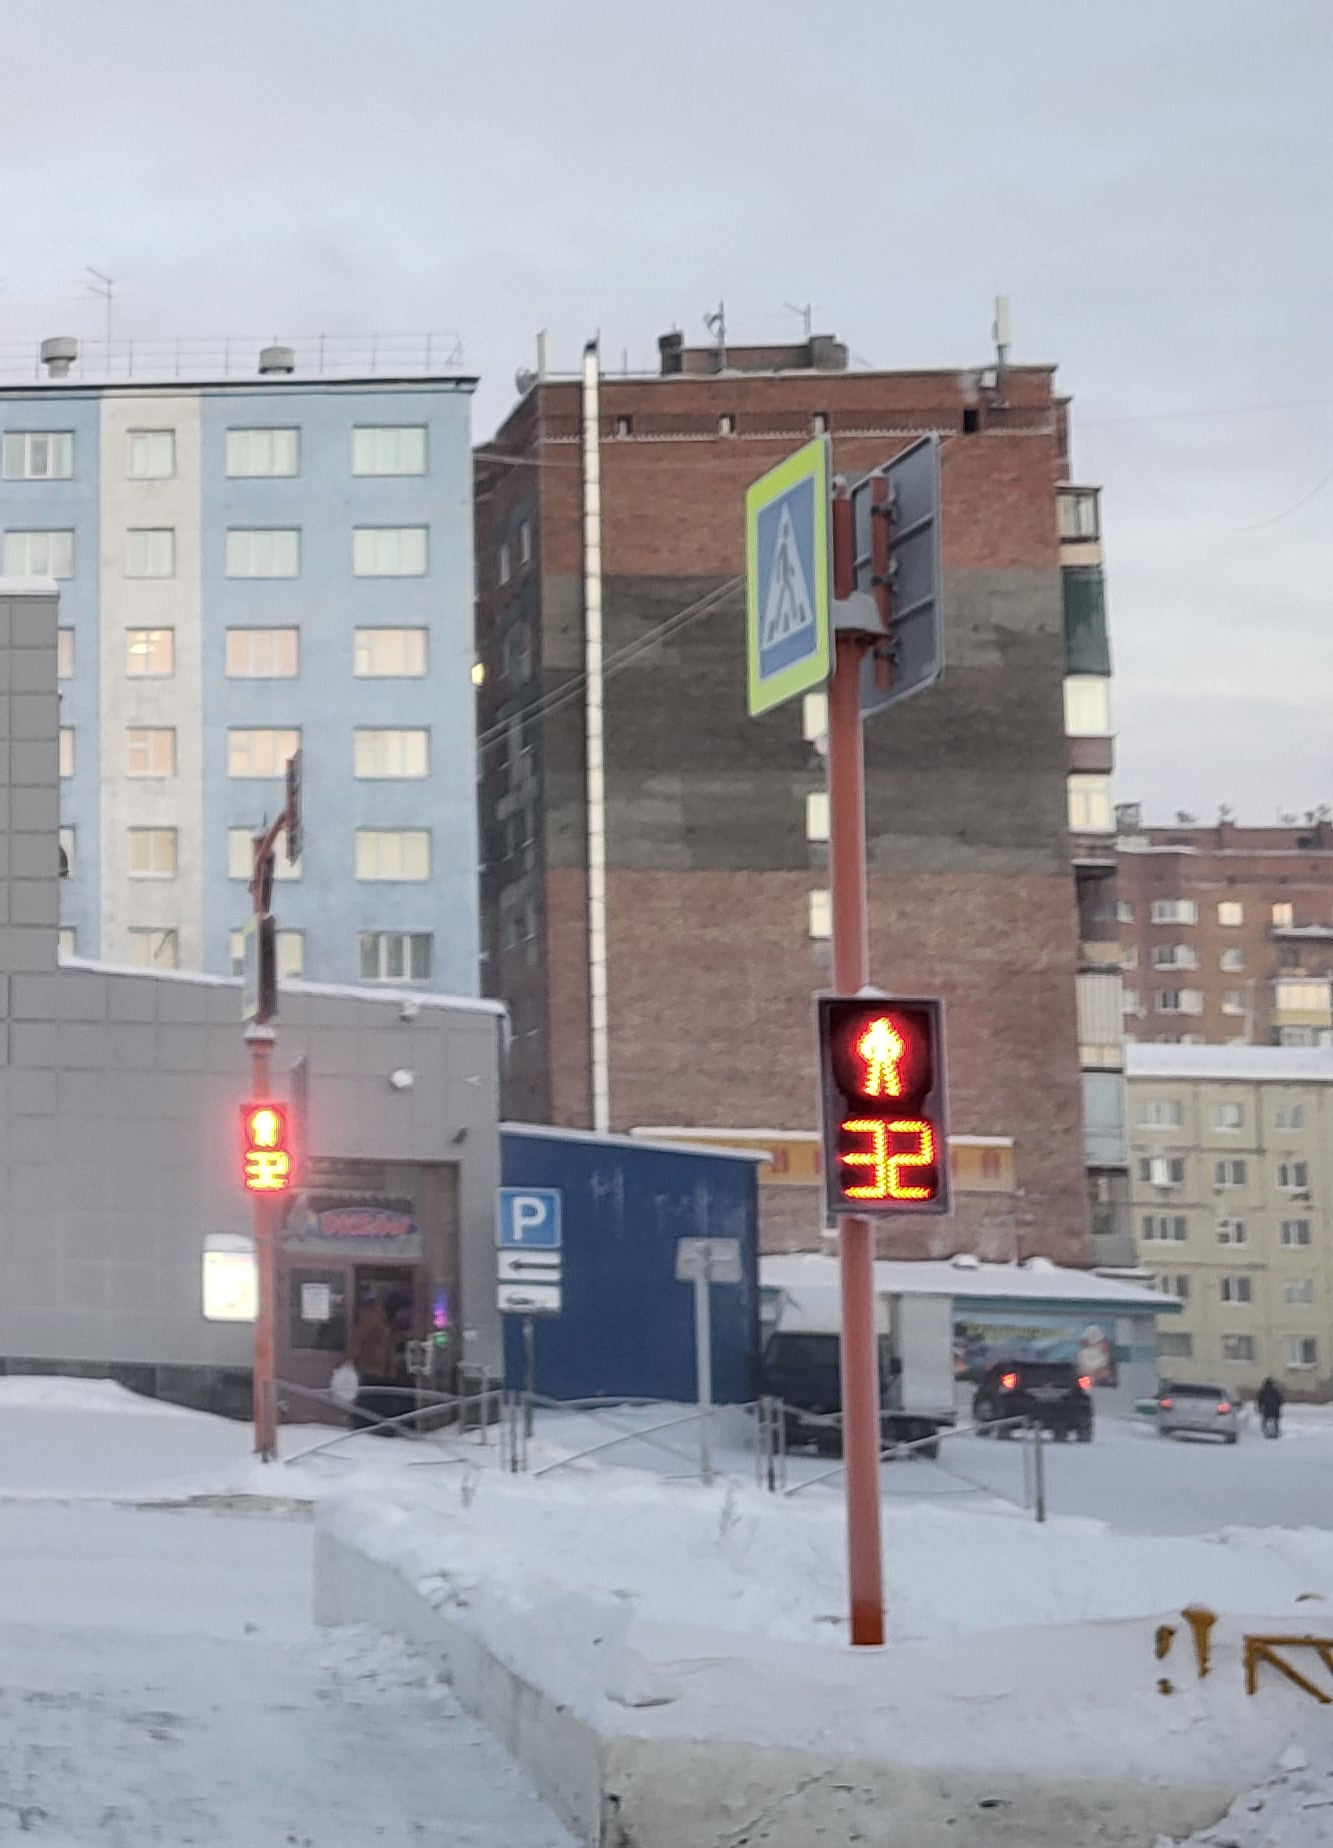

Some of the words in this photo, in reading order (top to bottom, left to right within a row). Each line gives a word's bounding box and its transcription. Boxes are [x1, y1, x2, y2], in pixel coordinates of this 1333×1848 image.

[244, 1151, 290, 1189] 32
[841, 1120, 933, 1198] 32
[513, 1197, 546, 1242] P
